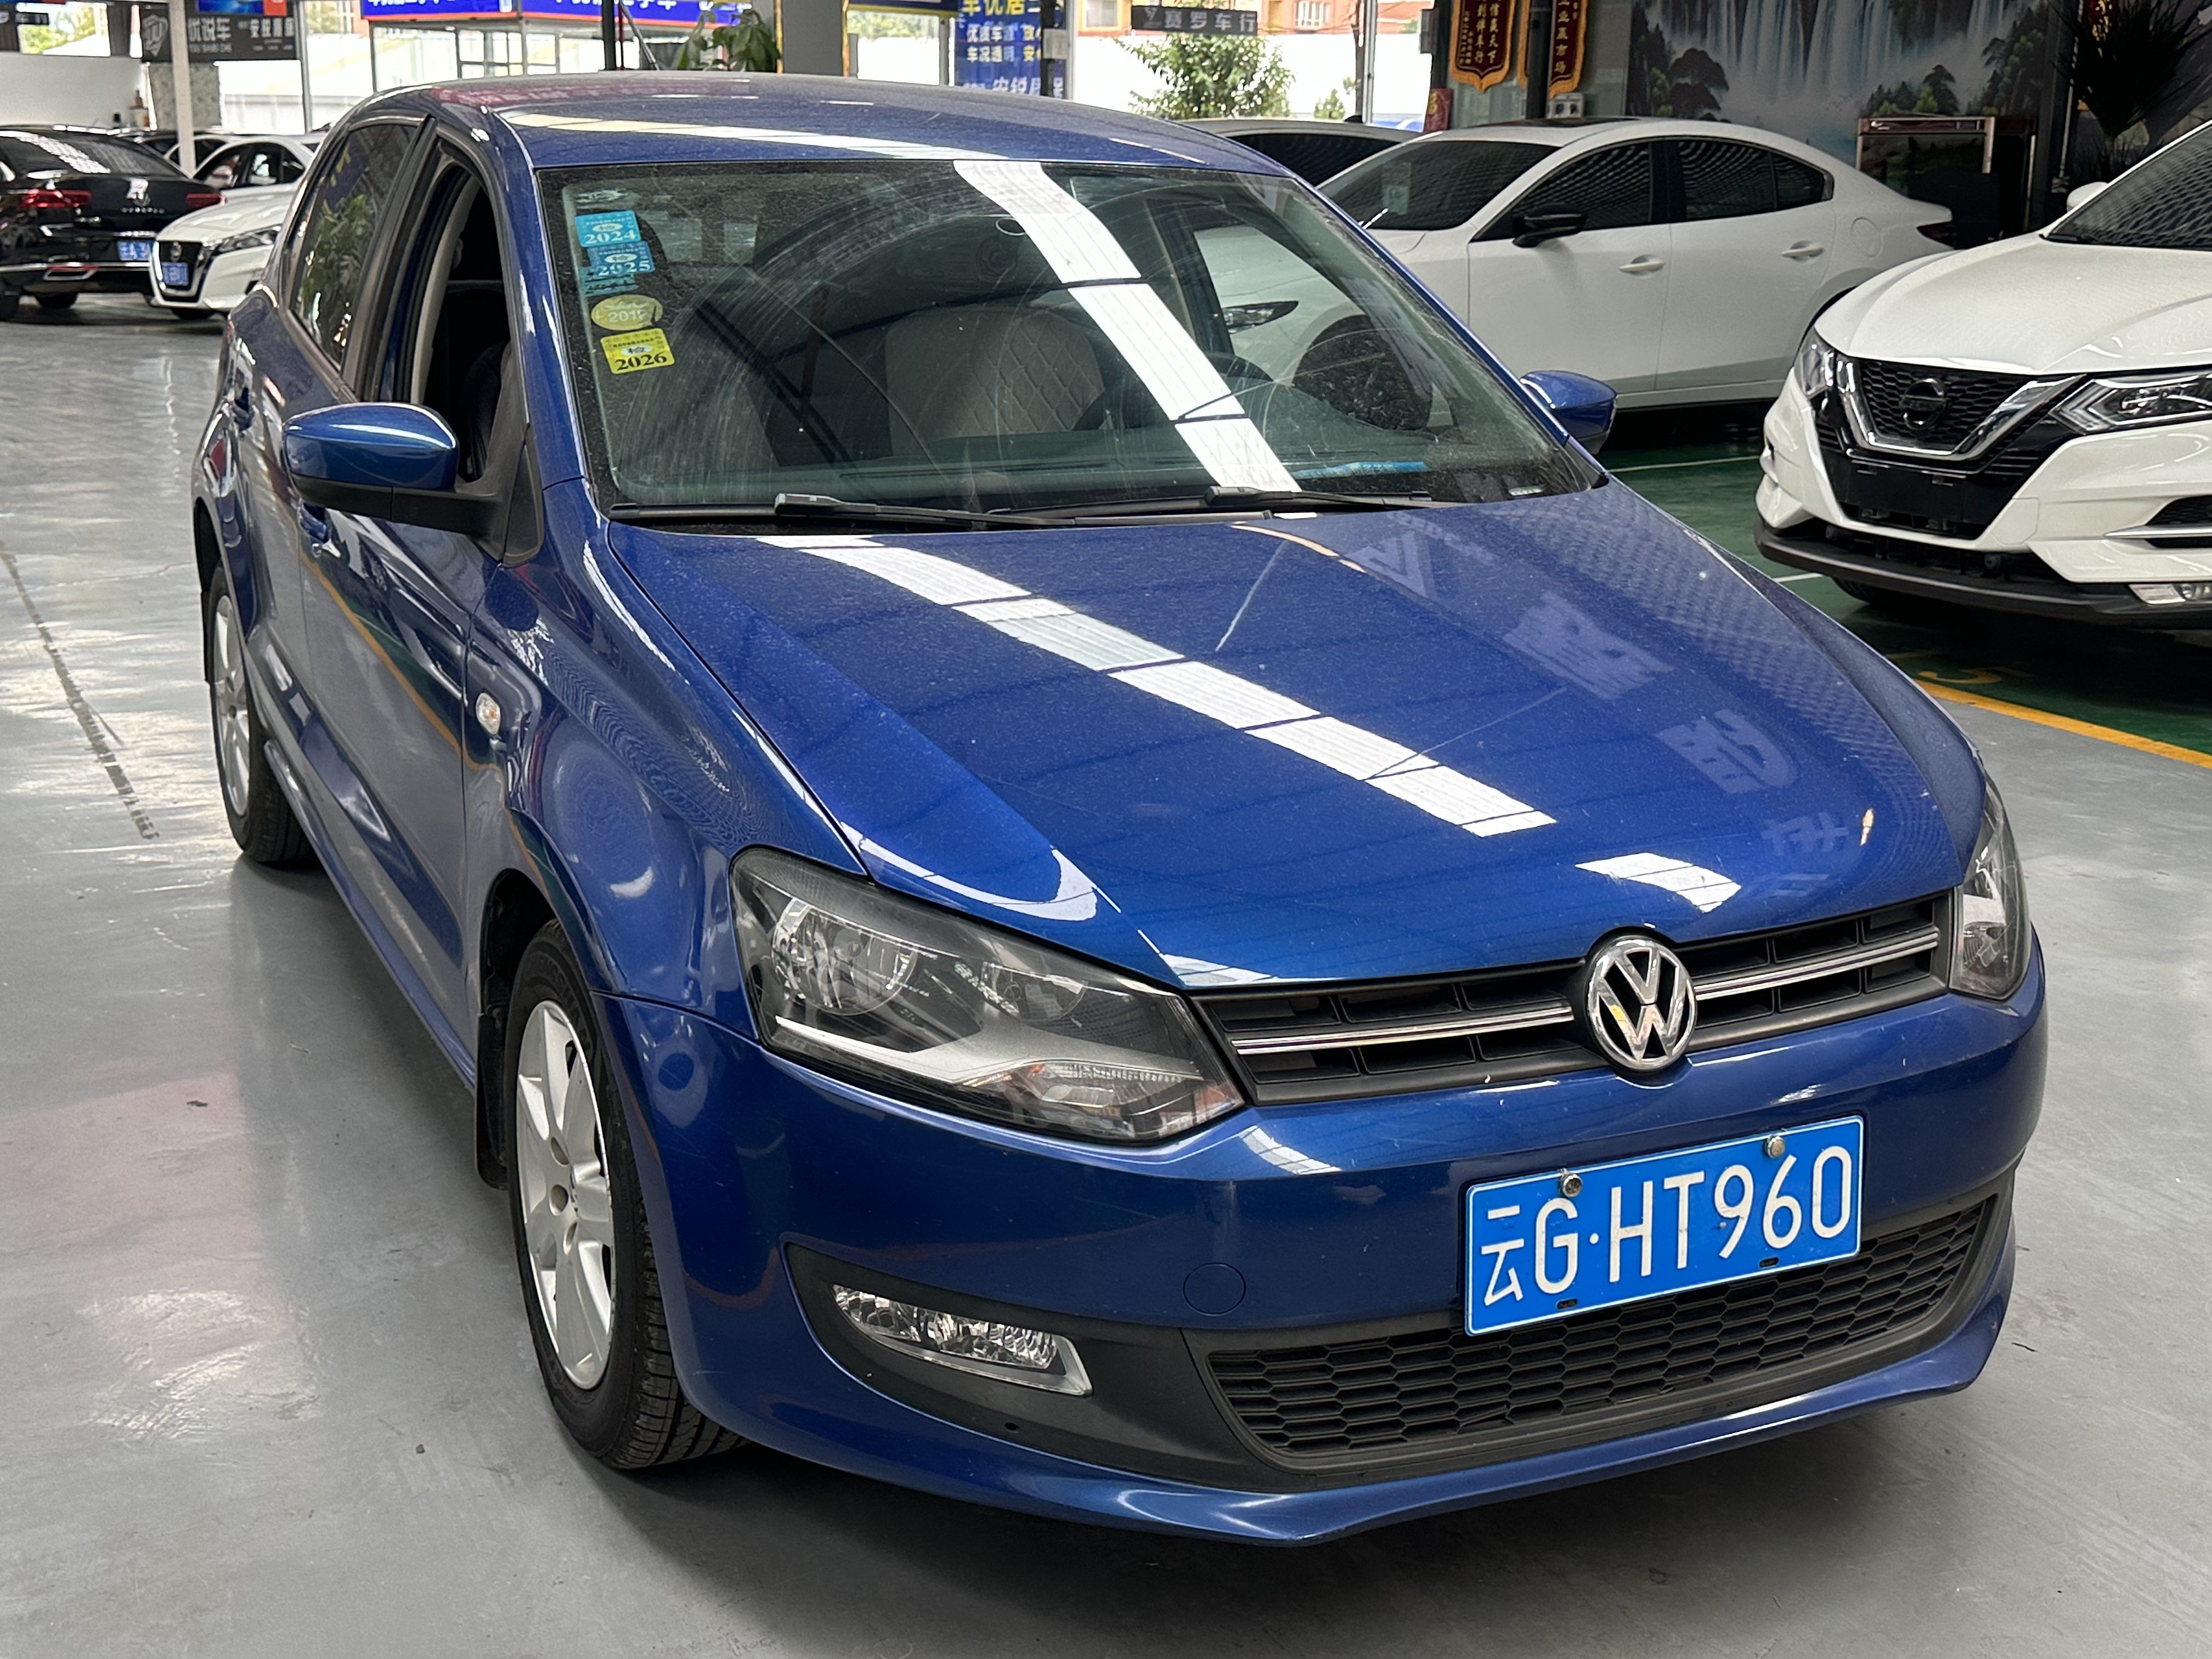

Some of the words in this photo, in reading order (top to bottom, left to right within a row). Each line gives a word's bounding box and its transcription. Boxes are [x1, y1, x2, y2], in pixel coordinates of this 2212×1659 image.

[1164, 10, 1256, 32] 赛罗车行
[584, 230, 635, 244] 2024
[598, 260, 651, 276] 2025
[615, 353, 667, 371] 2026
